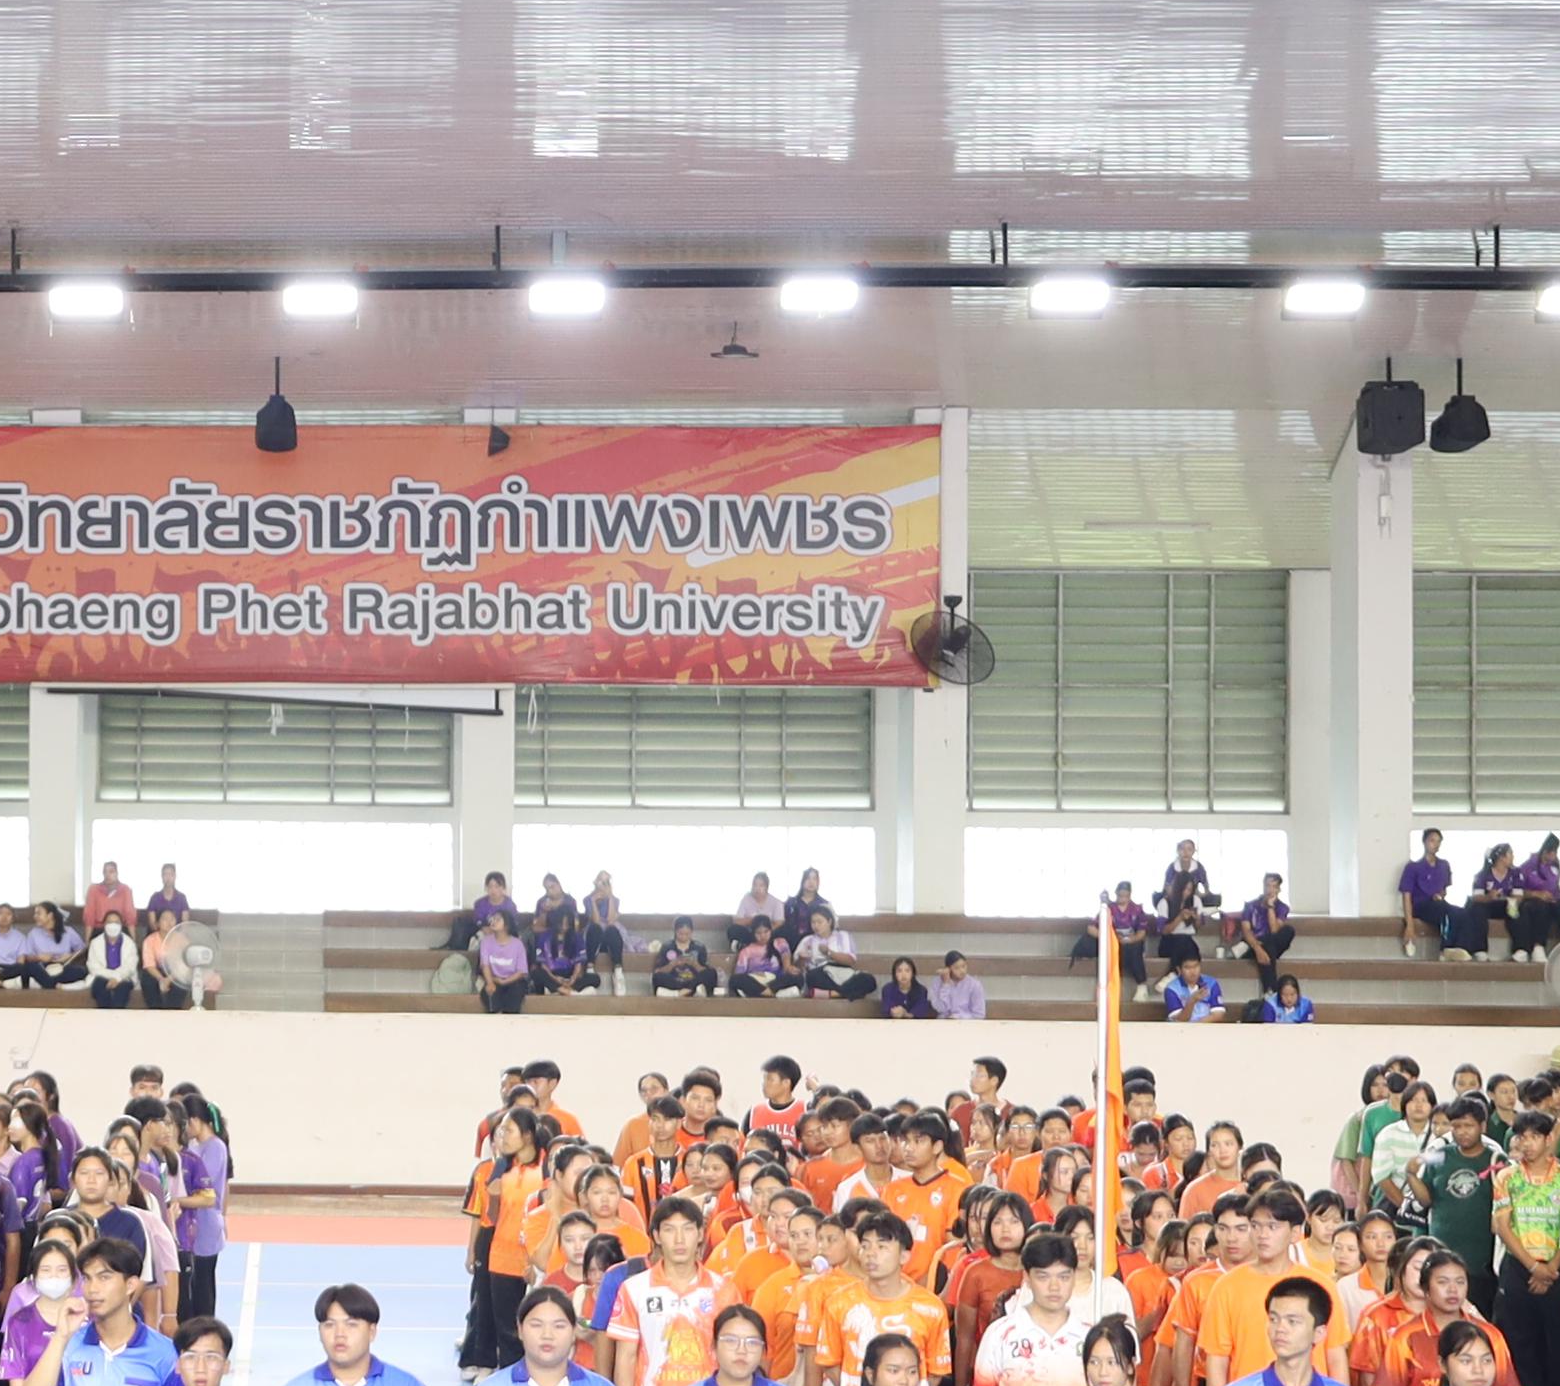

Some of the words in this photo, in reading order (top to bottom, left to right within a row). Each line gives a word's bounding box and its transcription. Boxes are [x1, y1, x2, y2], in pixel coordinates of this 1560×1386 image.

[203, 587, 322, 631] Phet
[348, 587, 585, 641] Rajabhat
[612, 587, 880, 641] University
